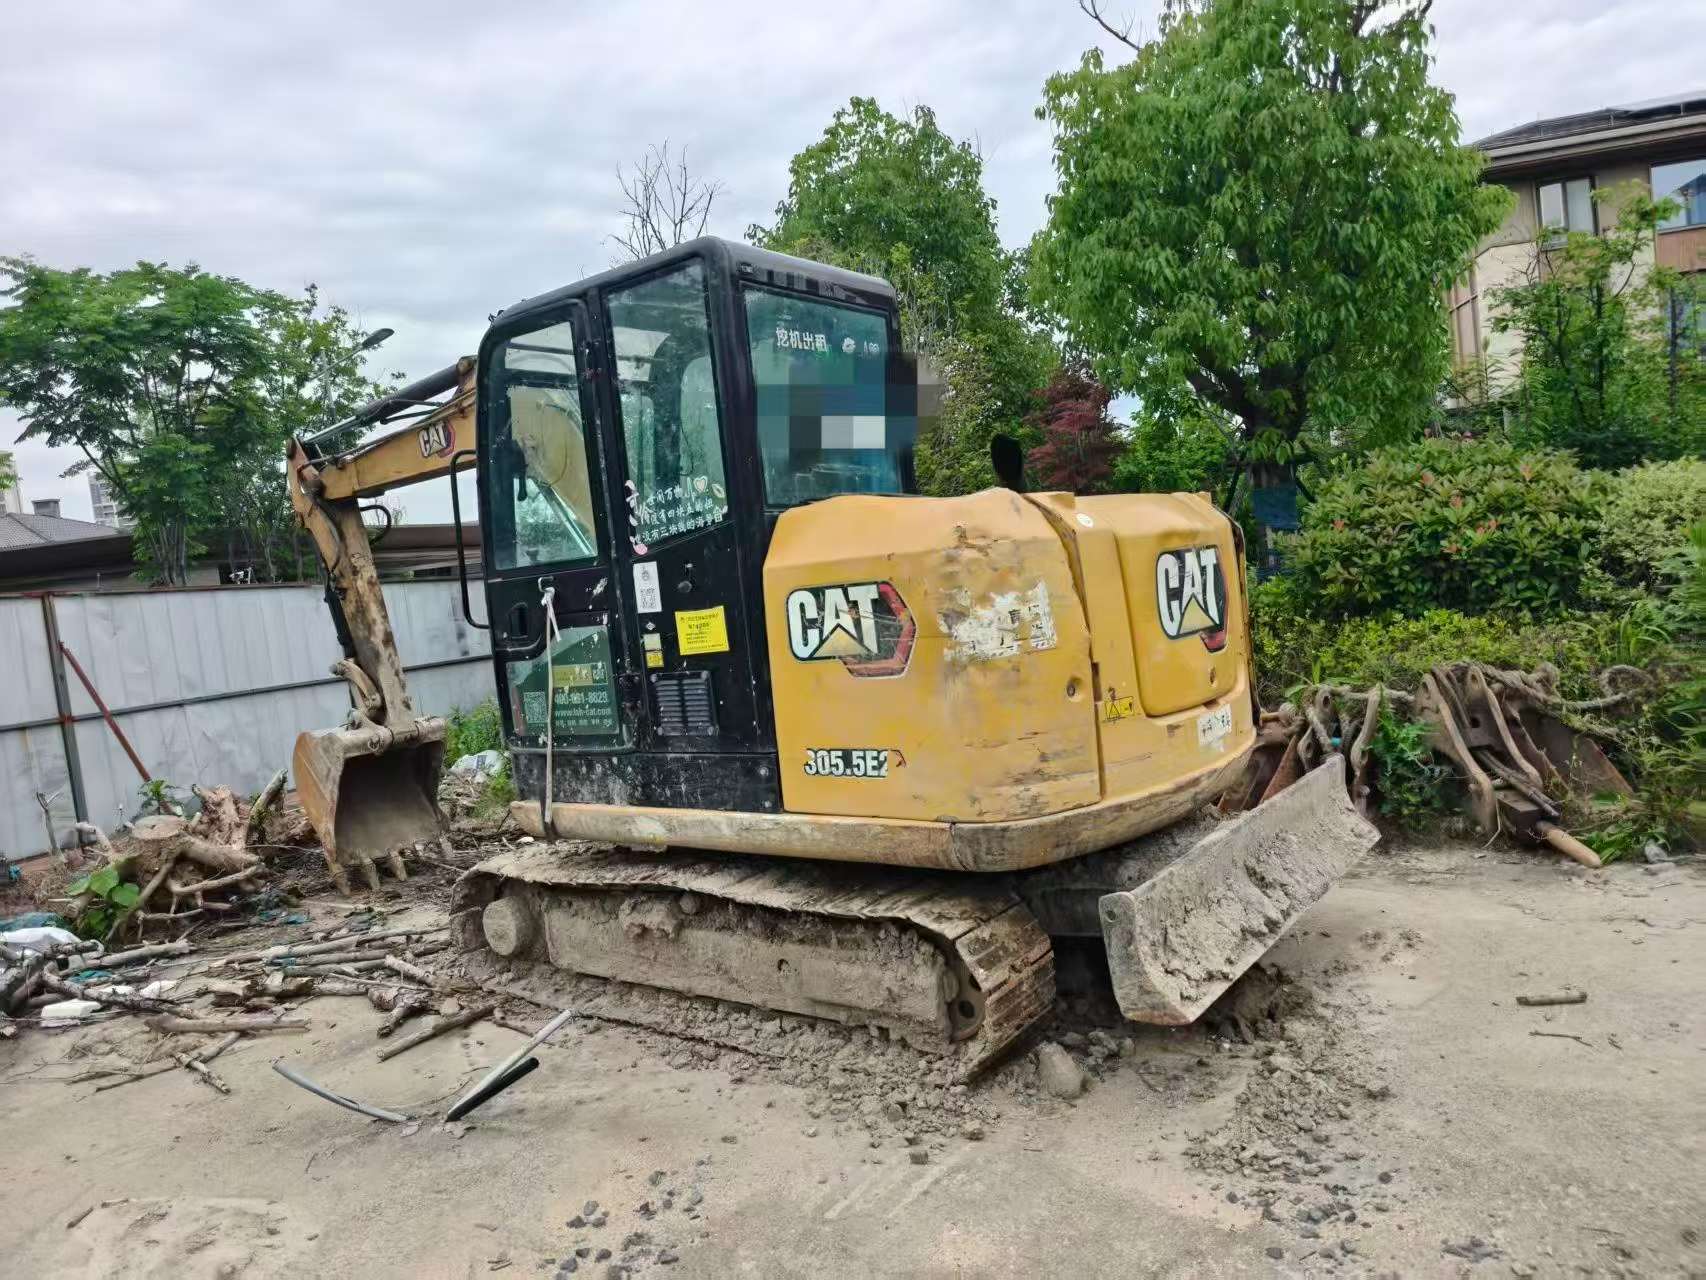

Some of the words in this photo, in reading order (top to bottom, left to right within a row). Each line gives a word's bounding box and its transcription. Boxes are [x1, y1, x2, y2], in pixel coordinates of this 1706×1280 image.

[776, 327, 828, 352] 挖机出租
[418, 421, 447, 457] CAT
[1156, 547, 1220, 637] CAT
[788, 584, 879, 659] CAT
[804, 749, 889, 778] 305.5E2
